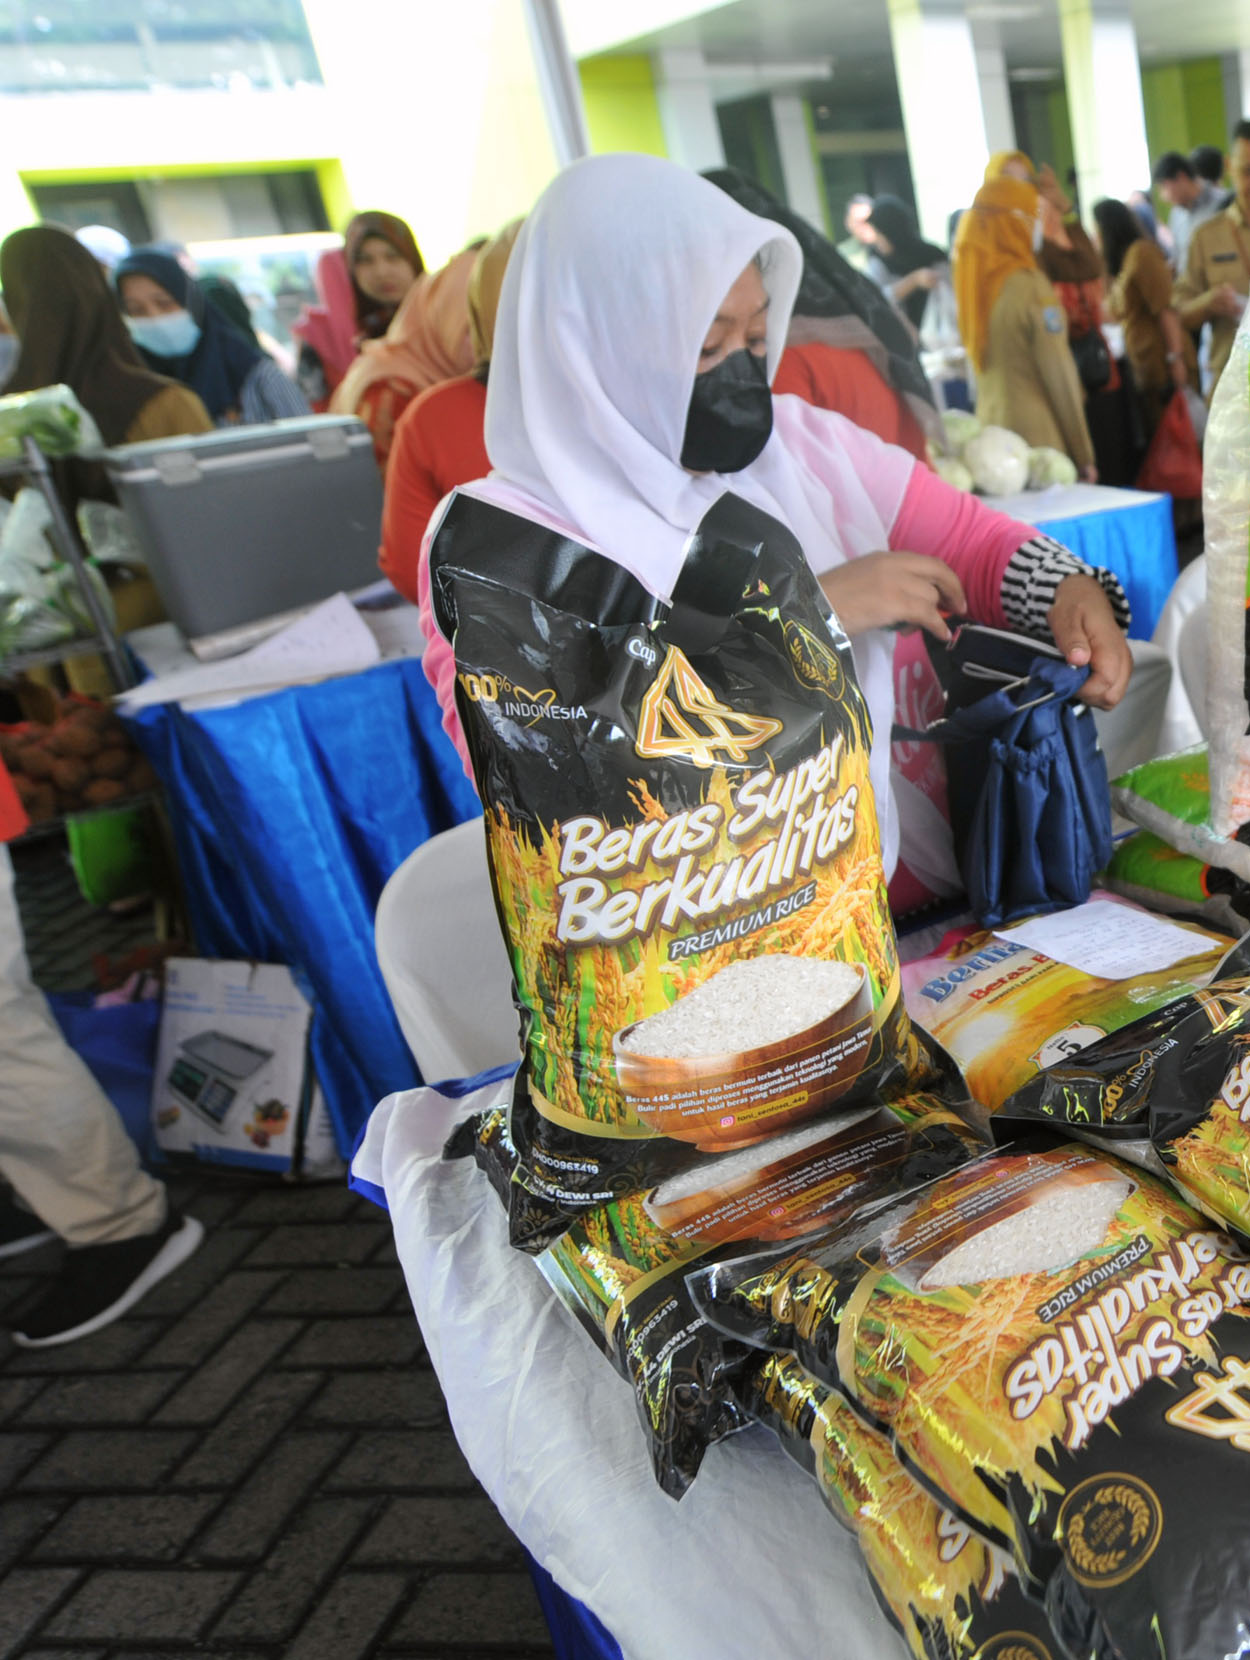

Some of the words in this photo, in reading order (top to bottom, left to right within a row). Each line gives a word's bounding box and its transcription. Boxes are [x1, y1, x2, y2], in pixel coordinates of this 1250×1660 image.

[626, 635, 657, 667] Cap
[504, 700, 588, 721] INDONESIA
[557, 801, 724, 877] Beras
[728, 732, 845, 844] Super
[555, 784, 859, 945] Berkualitas
[668, 899, 774, 961] PREMIUM
[774, 882, 817, 926] RICE
[920, 938, 1028, 1004] Berlia
[700, 1085, 721, 1096] beras
[784, 1063, 798, 1078] dari
[1130, 1037, 1179, 1089] INDONESIA
[659, 1103, 676, 1112] padi
[679, 1099, 705, 1110] pilihan
[707, 1091, 740, 1104] diproses
[707, 1101, 725, 1112] hasil
[727, 1096, 748, 1108] beras
[750, 1091, 768, 1103] yang
[1077, 1237, 1150, 1296] PREMIUM
[1039, 1291, 1079, 1322] RICE
[1064, 1320, 1182, 1450] Super
